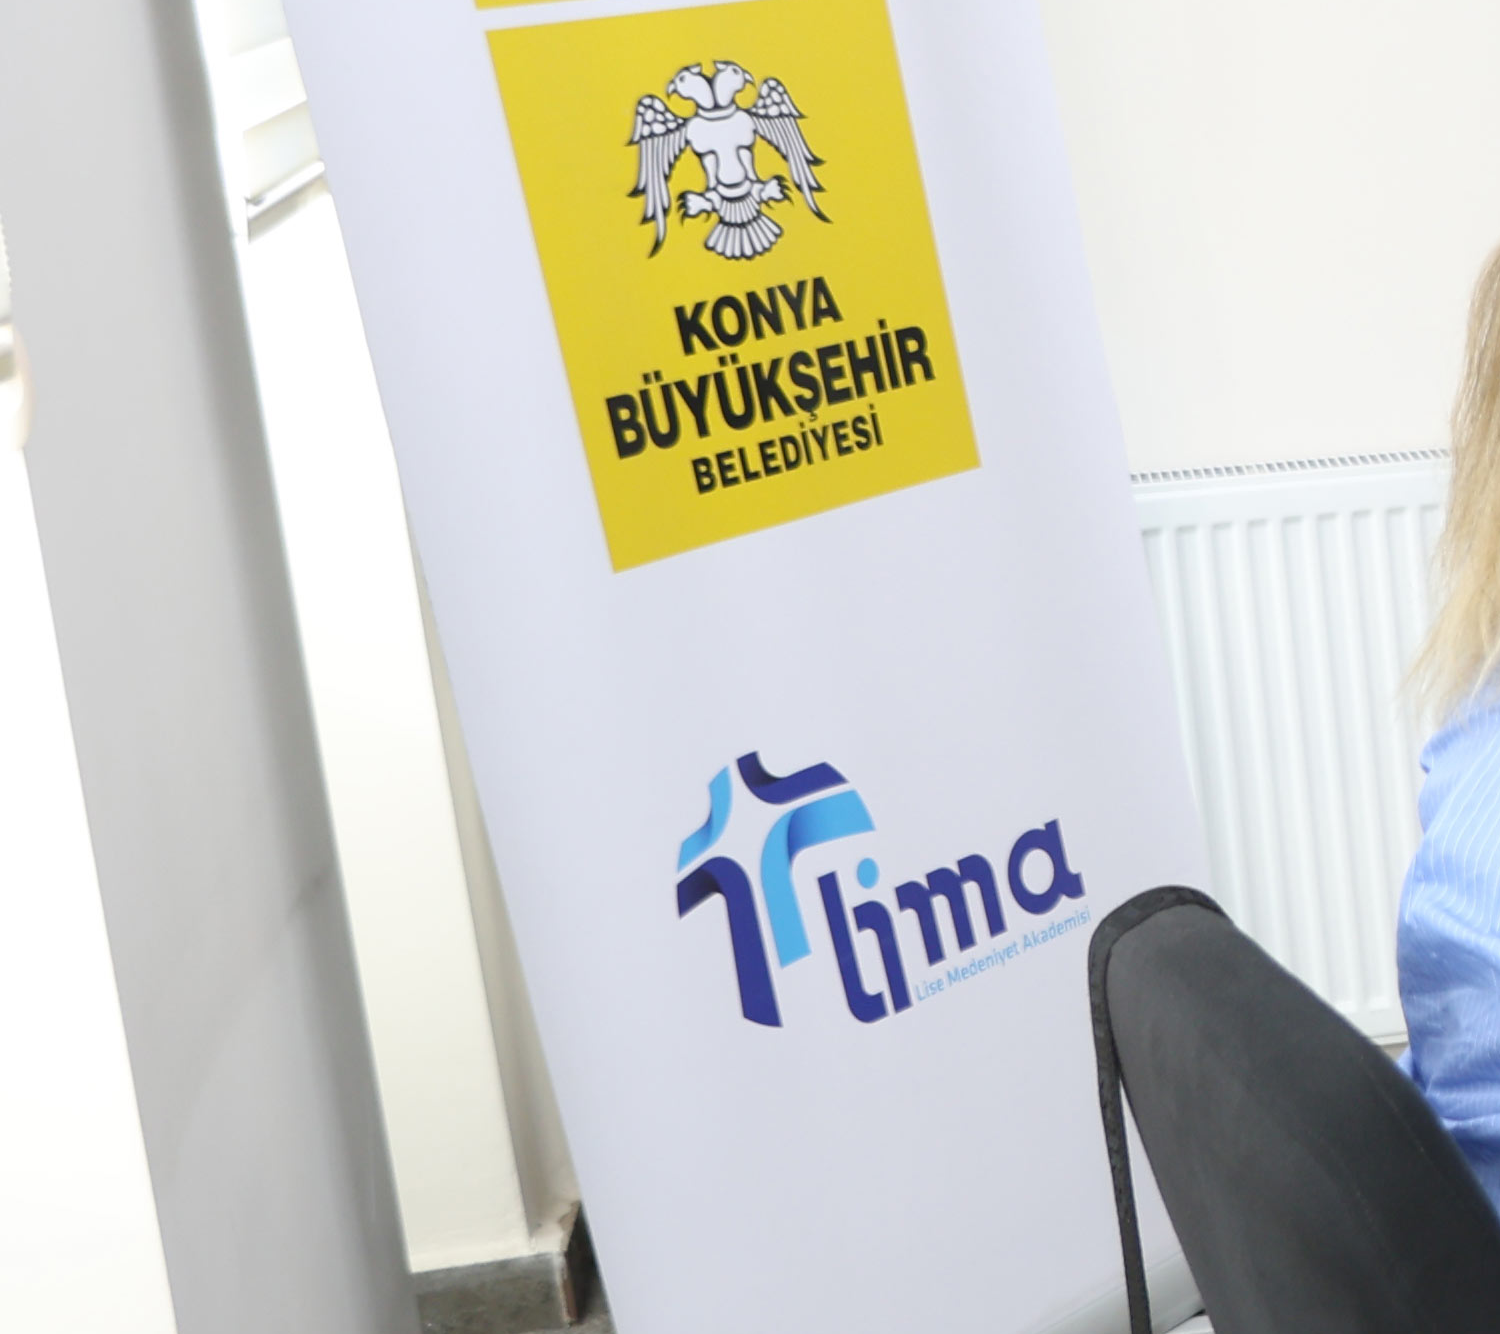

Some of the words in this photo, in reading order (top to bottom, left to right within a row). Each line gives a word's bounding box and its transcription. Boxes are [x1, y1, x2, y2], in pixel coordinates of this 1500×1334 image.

[674, 275, 843, 357] KONYA
[605, 319, 936, 460] BÜYÜKŞEHİR
[692, 405, 884, 496] BELEDİYESİ
[817, 817, 1086, 1024] lima
[915, 976, 945, 1002] Lise
[947, 939, 1020, 988] Medeniyet
[1022, 905, 1092, 956] Akademisi
